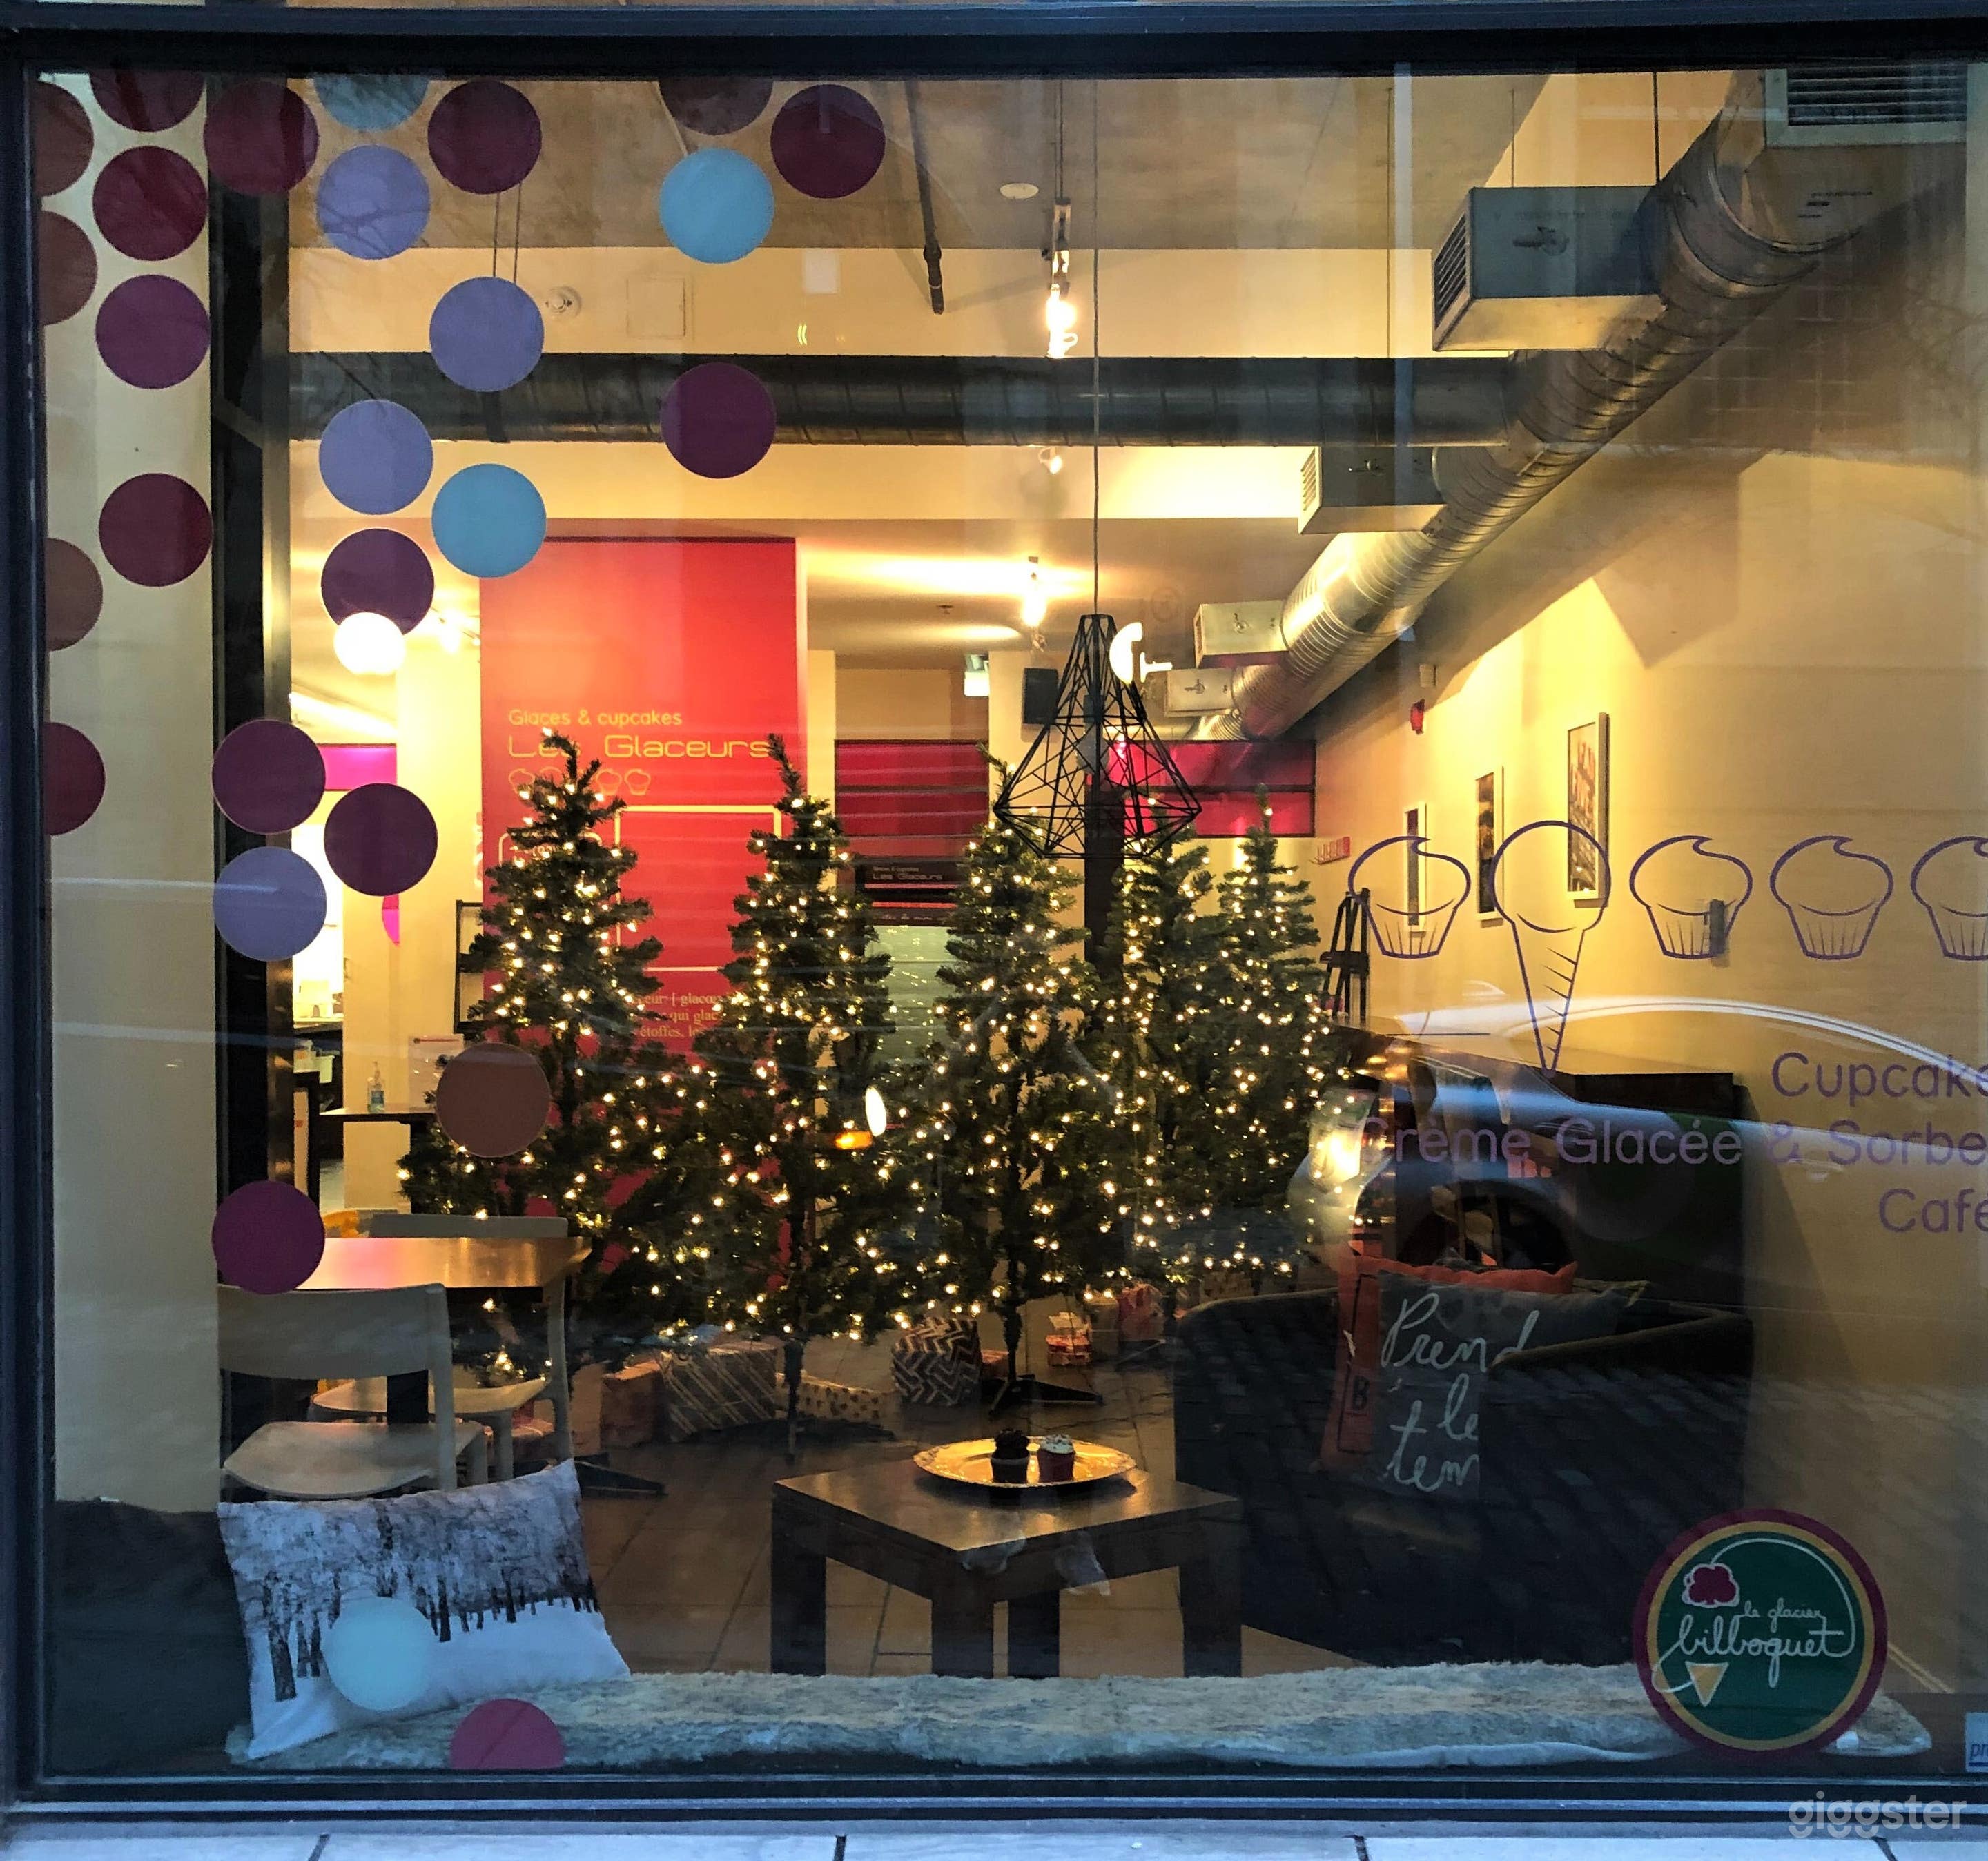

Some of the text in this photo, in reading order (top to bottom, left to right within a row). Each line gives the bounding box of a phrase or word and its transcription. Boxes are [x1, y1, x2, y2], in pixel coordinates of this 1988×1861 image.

[508, 708, 683, 730] Glaces & cupcakes
[604, 734, 771, 759] Glaceurs
[693, 1009, 720, 1026] glac
[1555, 1117, 1743, 1165] Glacée
[1767, 1120, 1804, 1164] &
[1744, 1597, 1824, 1633] le glacier
